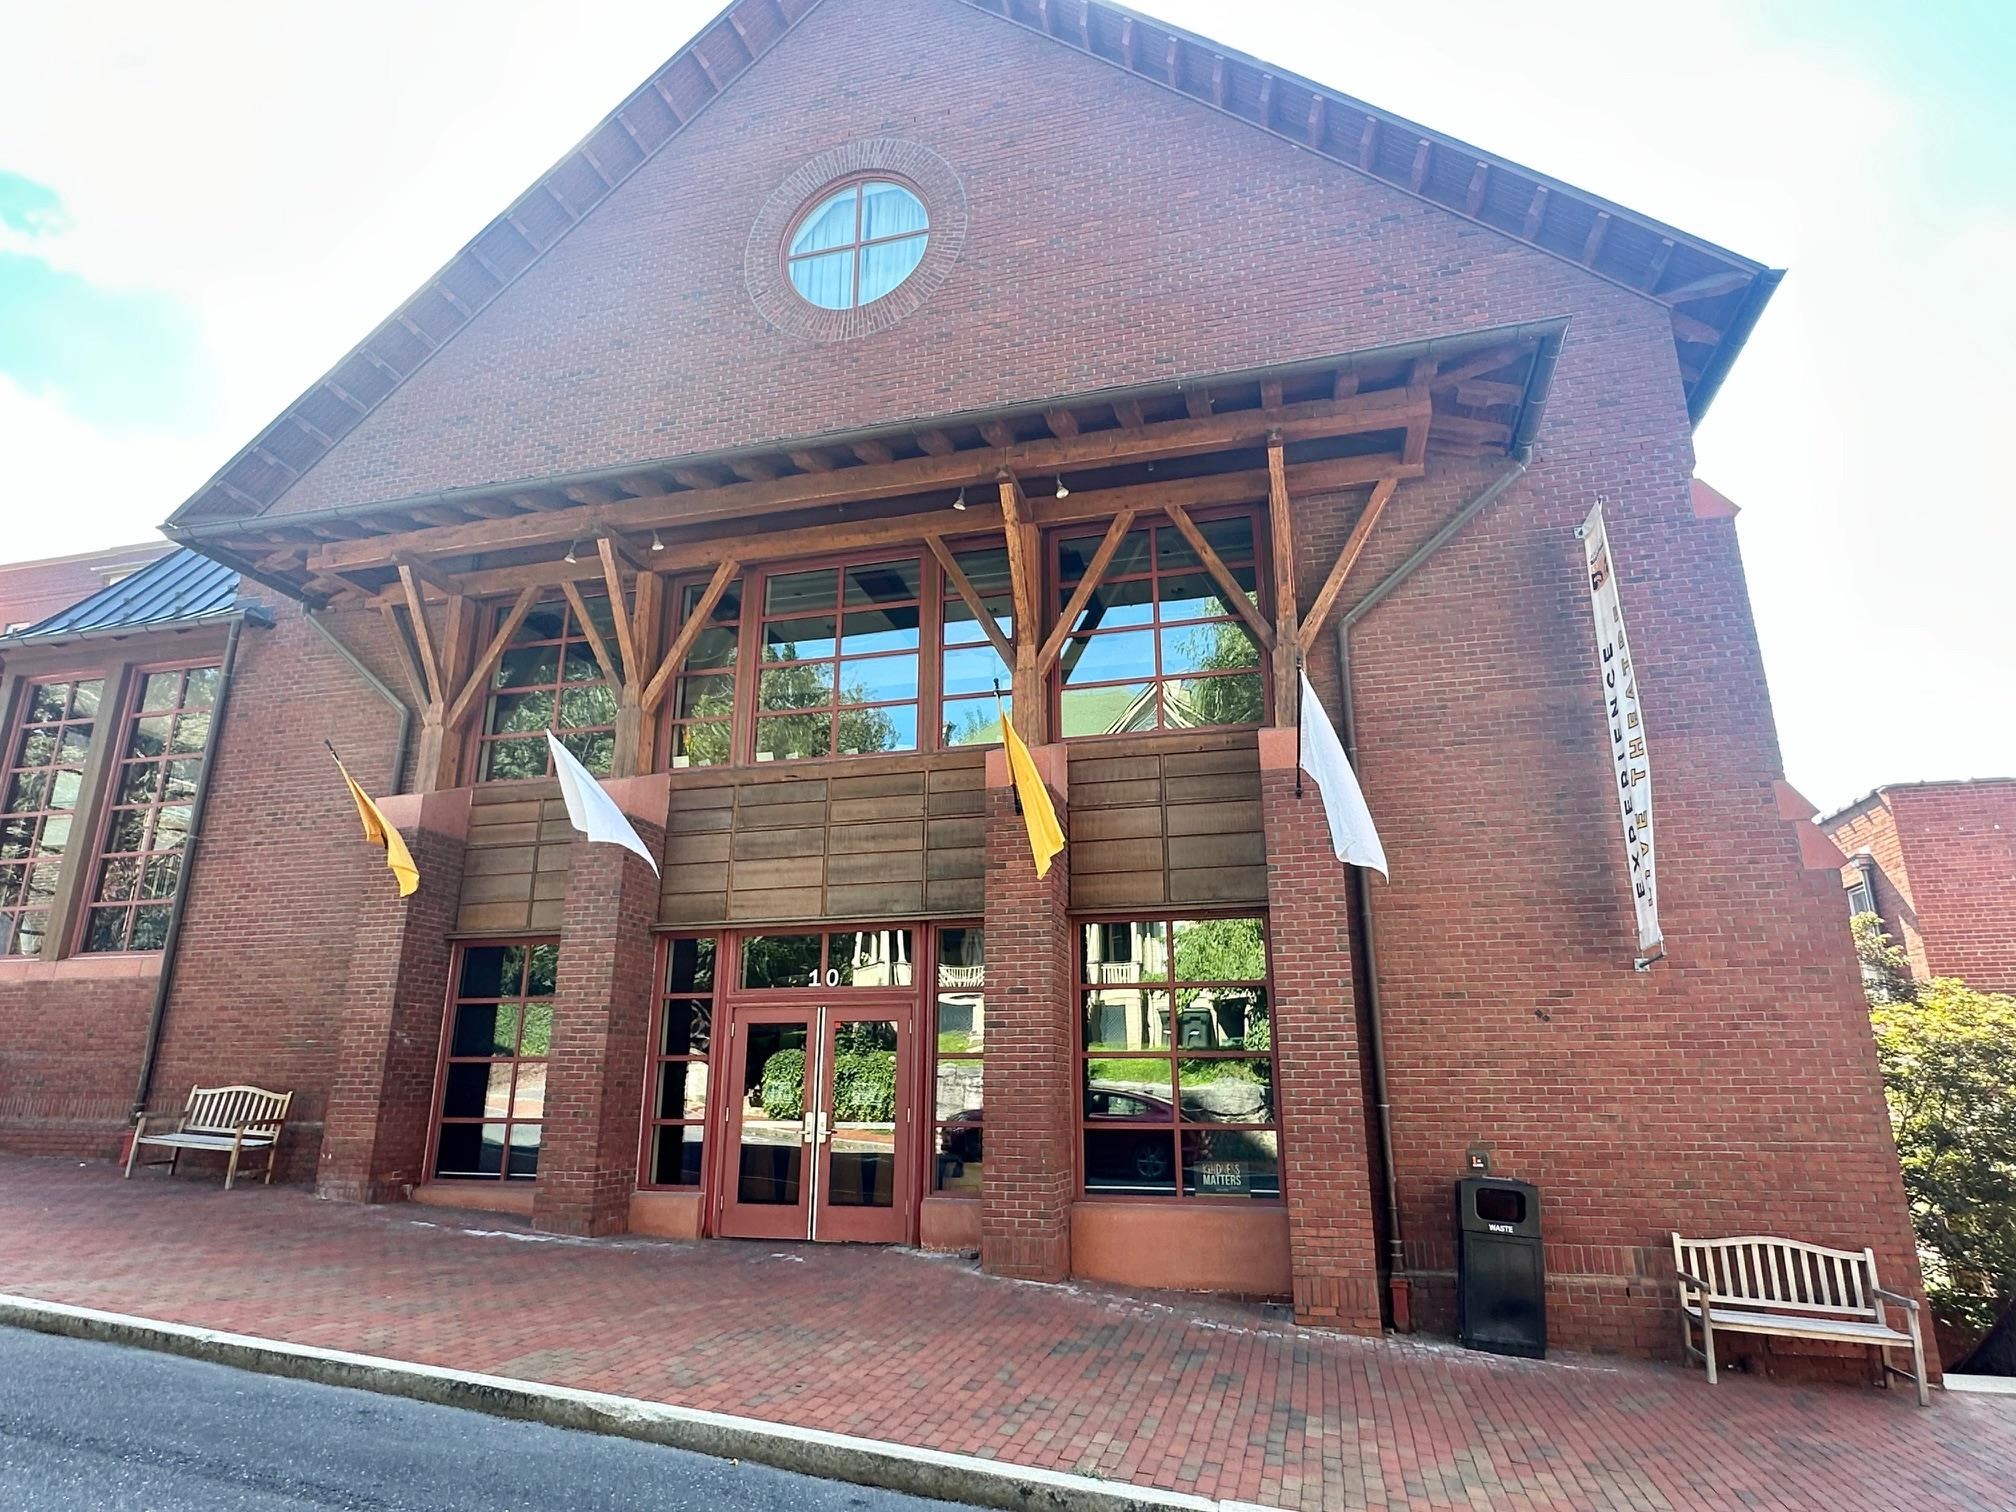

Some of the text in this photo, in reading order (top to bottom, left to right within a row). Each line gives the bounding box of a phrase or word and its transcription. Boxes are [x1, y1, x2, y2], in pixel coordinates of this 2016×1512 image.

[1602, 642, 1646, 899] EXPERIENCE
[808, 968, 840, 987] 10
[1202, 1174, 1242, 1186] MATTERS
[1488, 1223, 1514, 1234] WASTE
